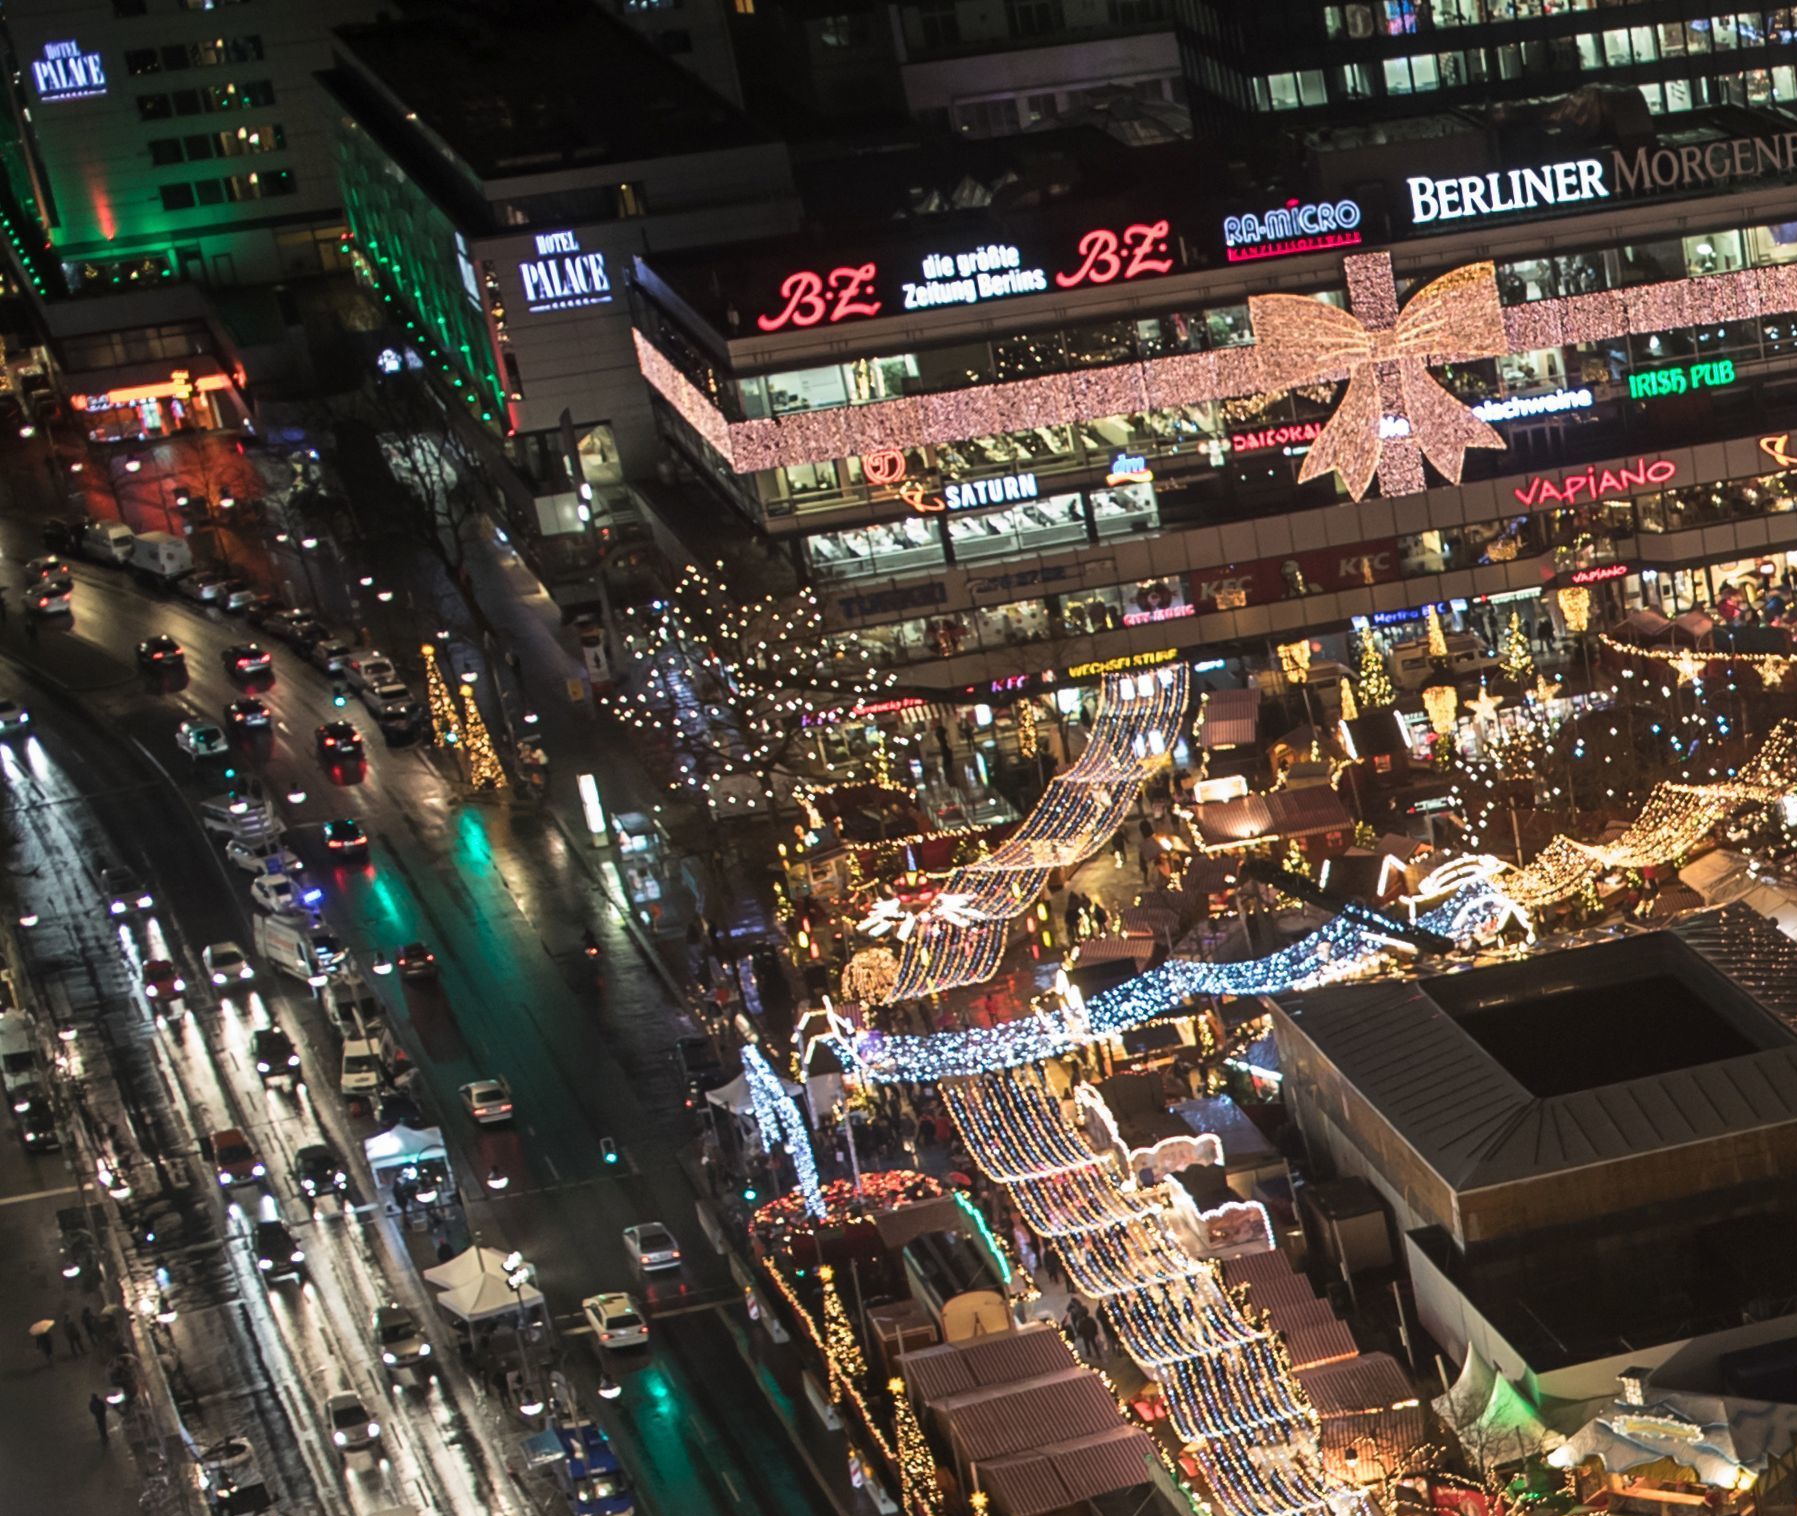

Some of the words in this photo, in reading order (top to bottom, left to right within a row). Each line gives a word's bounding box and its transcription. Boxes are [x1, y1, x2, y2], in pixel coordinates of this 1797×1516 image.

[44, 41, 80, 60] HOTEL
[33, 54, 105, 92] PALACE
[1407, 158, 1610, 224] BERLINER
[535, 231, 580, 255] HOTEL
[519, 253, 611, 301] PALACE
[923, 254, 955, 279] die
[956, 244, 1020, 278] größte
[902, 277, 977, 310] Zeitung
[978, 267, 1047, 299] Berlins
[1690, 360, 1736, 390] PUB
[1112, 454, 1146, 476] dm
[1514, 457, 1677, 507] VAPIANO
[945, 472, 1038, 510] SATURN
[1572, 564, 1628, 584] VAPIANO
